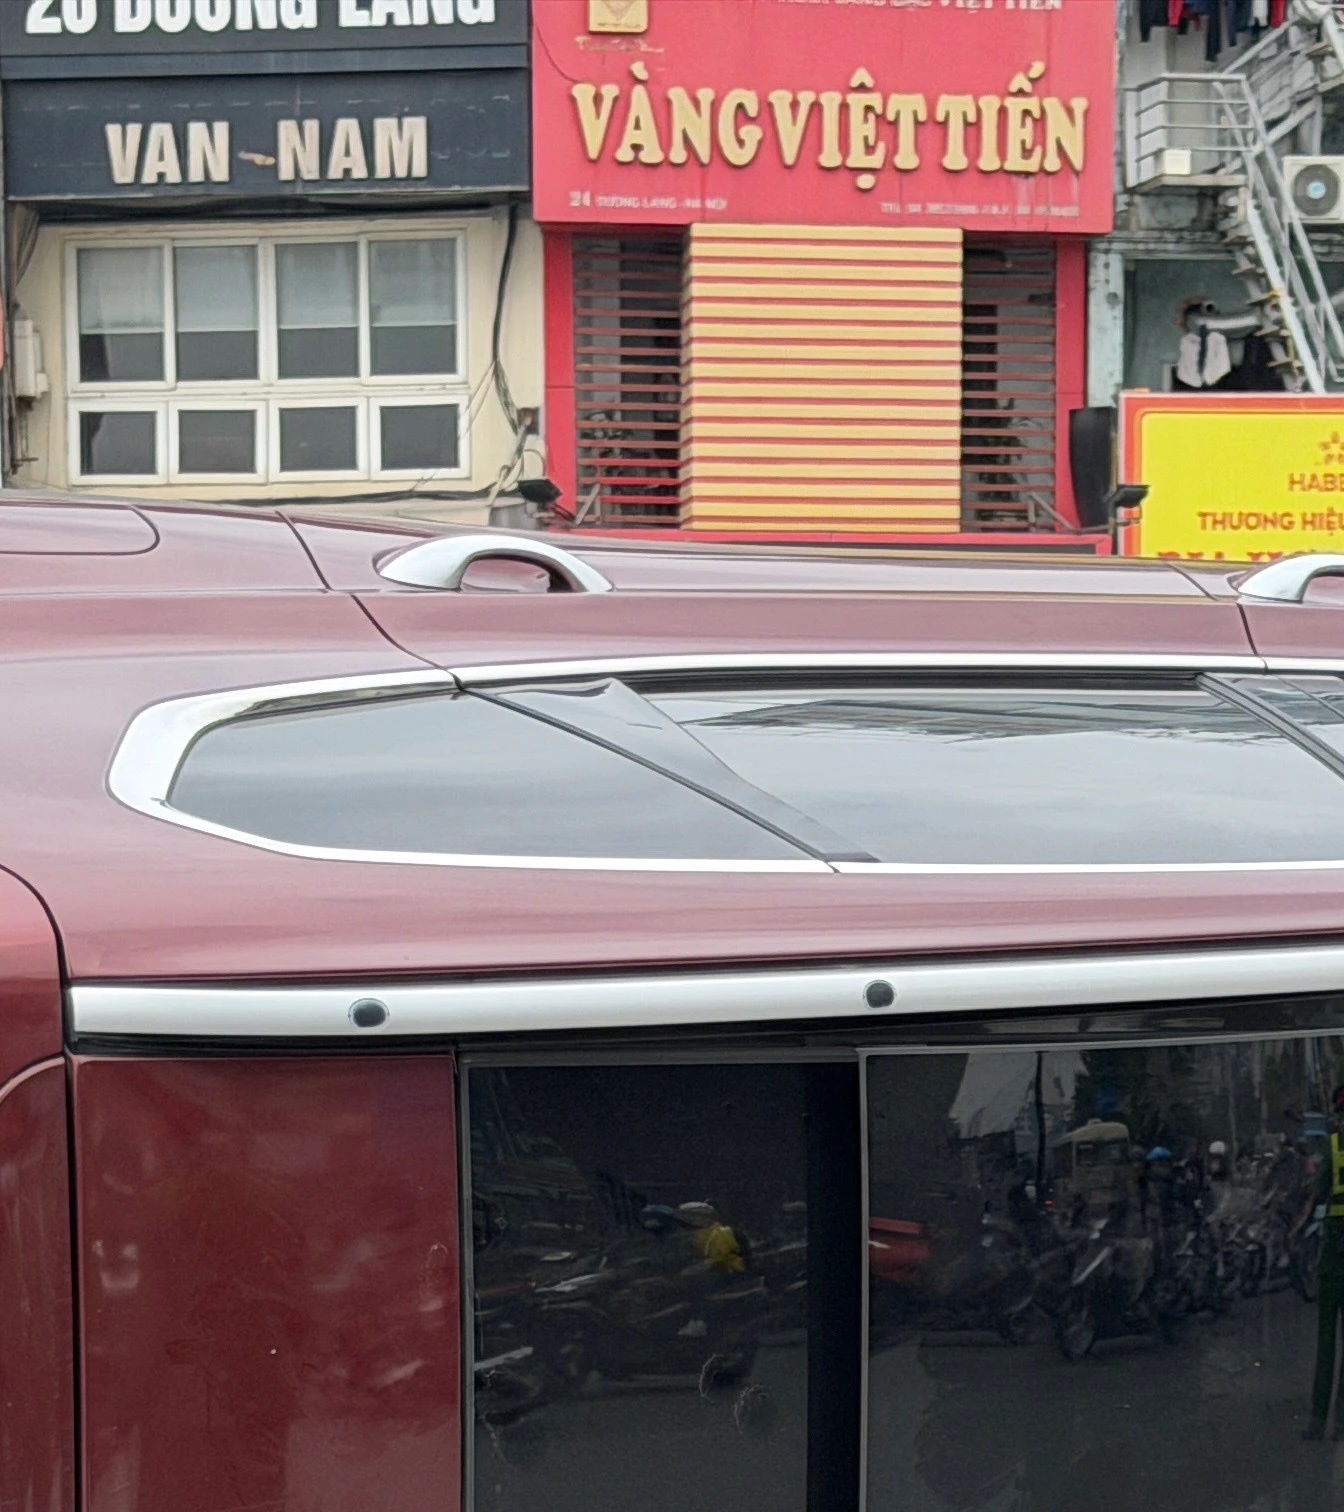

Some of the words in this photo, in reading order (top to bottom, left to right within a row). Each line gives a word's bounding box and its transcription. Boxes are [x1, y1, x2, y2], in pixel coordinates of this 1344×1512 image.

[105, 121, 230, 185] VAN
[277, 116, 428, 181] NAM
[571, 61, 763, 168] VÀNG
[768, 67, 928, 191] VIỆT
[935, 60, 1089, 173] TIẾN
